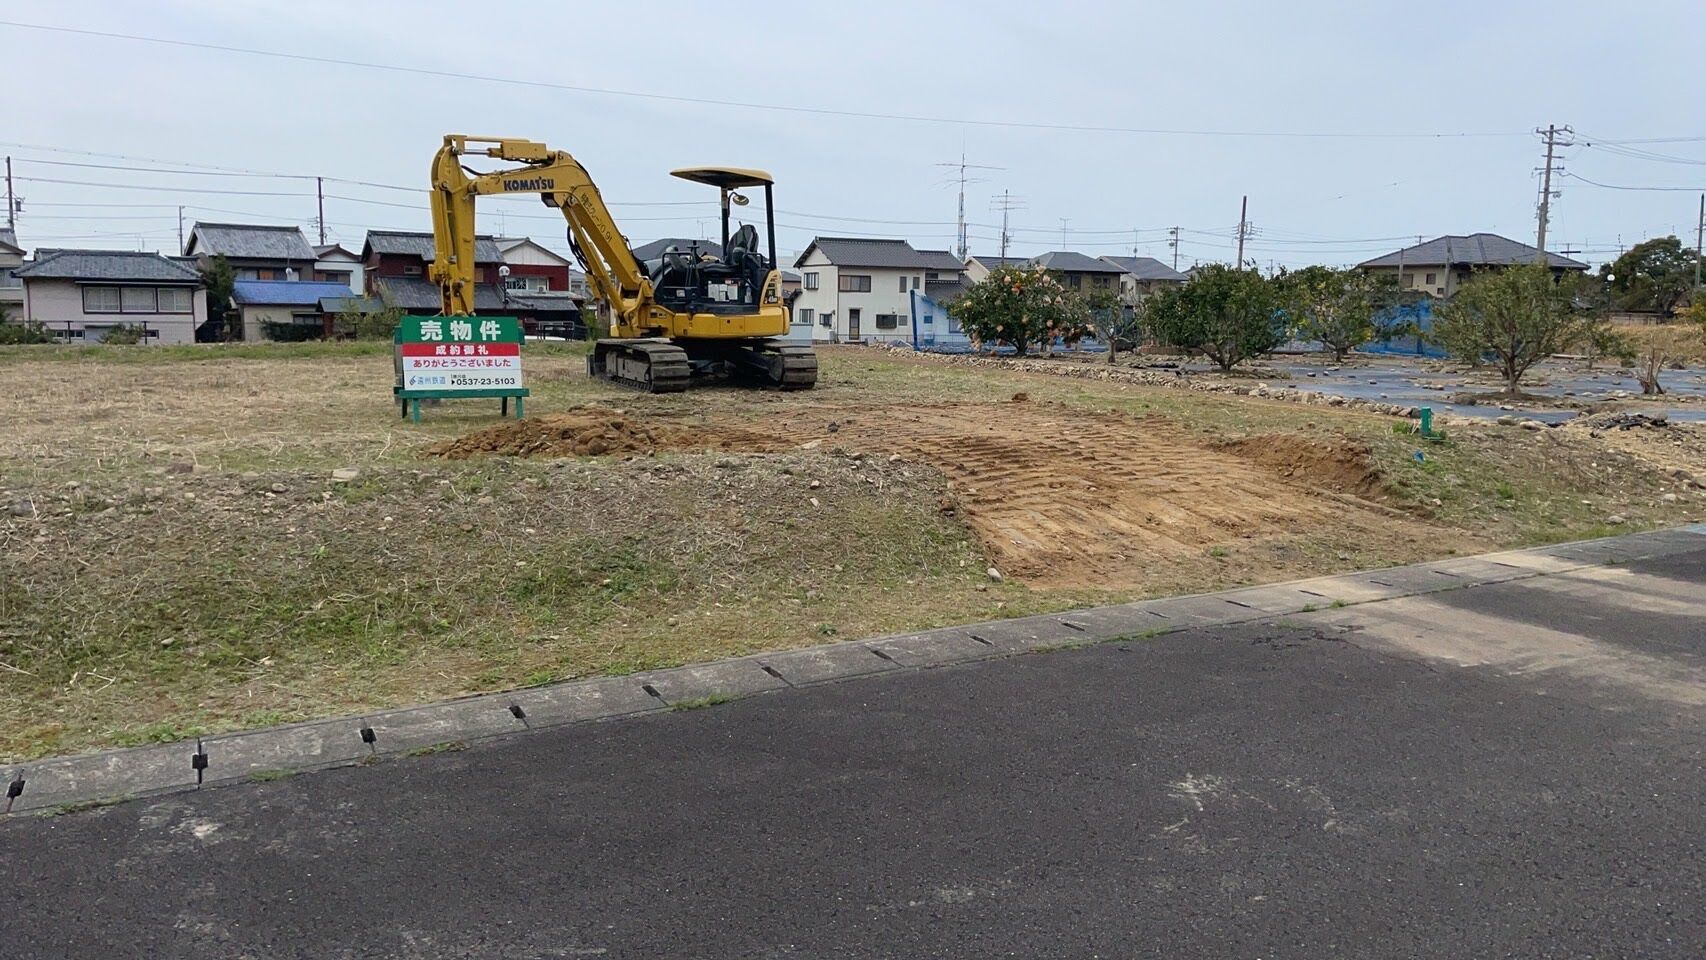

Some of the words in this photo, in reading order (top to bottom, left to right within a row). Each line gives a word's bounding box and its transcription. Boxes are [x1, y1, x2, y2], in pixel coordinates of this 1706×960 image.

[503, 177, 554, 191] KOMATSU
[420, 320, 502, 341] 売物件
[435, 345, 489, 354] 成約御礼
[413, 358, 512, 368] ありがとうございました
[456, 377, 516, 386] 0537-23-5103
